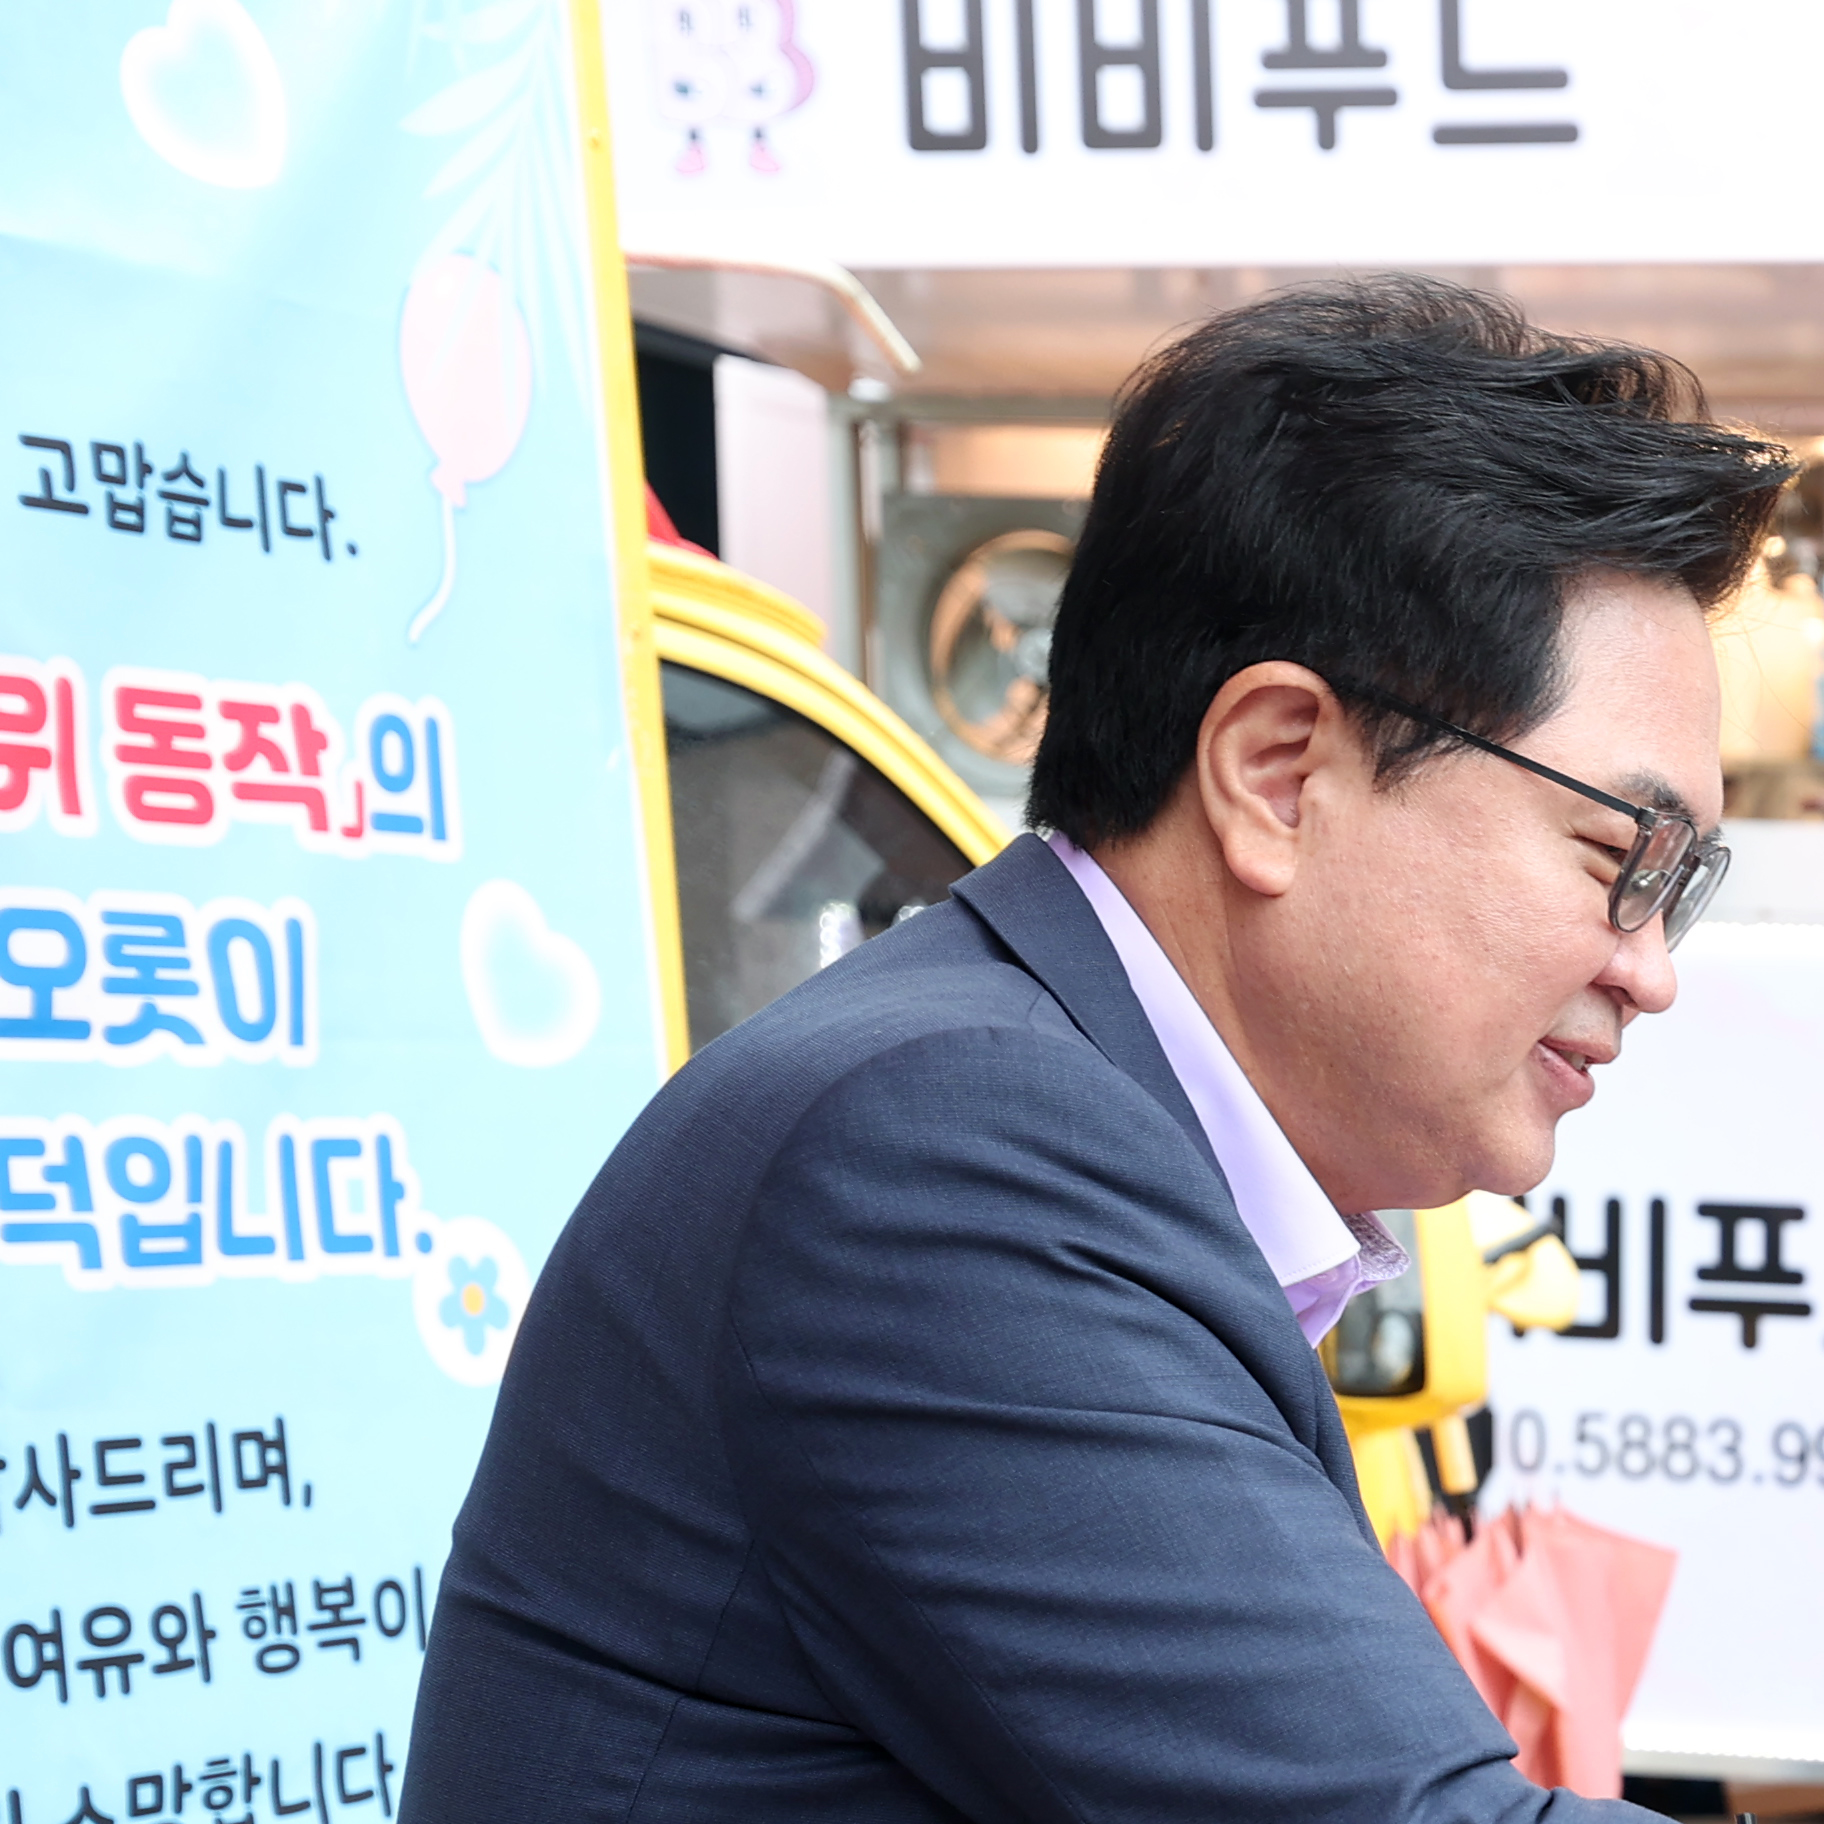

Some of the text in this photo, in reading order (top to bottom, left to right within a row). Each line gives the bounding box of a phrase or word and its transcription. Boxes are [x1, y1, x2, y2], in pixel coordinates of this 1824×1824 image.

[904, 0, 1580, 156] 비비푸드
[17, 432, 360, 562] 고맙습니다.
[0, 906, 304, 1047] 오롯이
[0, 1132, 434, 1270] 덕입니다.
[0, 1414, 313, 1530] 사드리며,
[3, 1564, 430, 1704] 여유와 행복이
